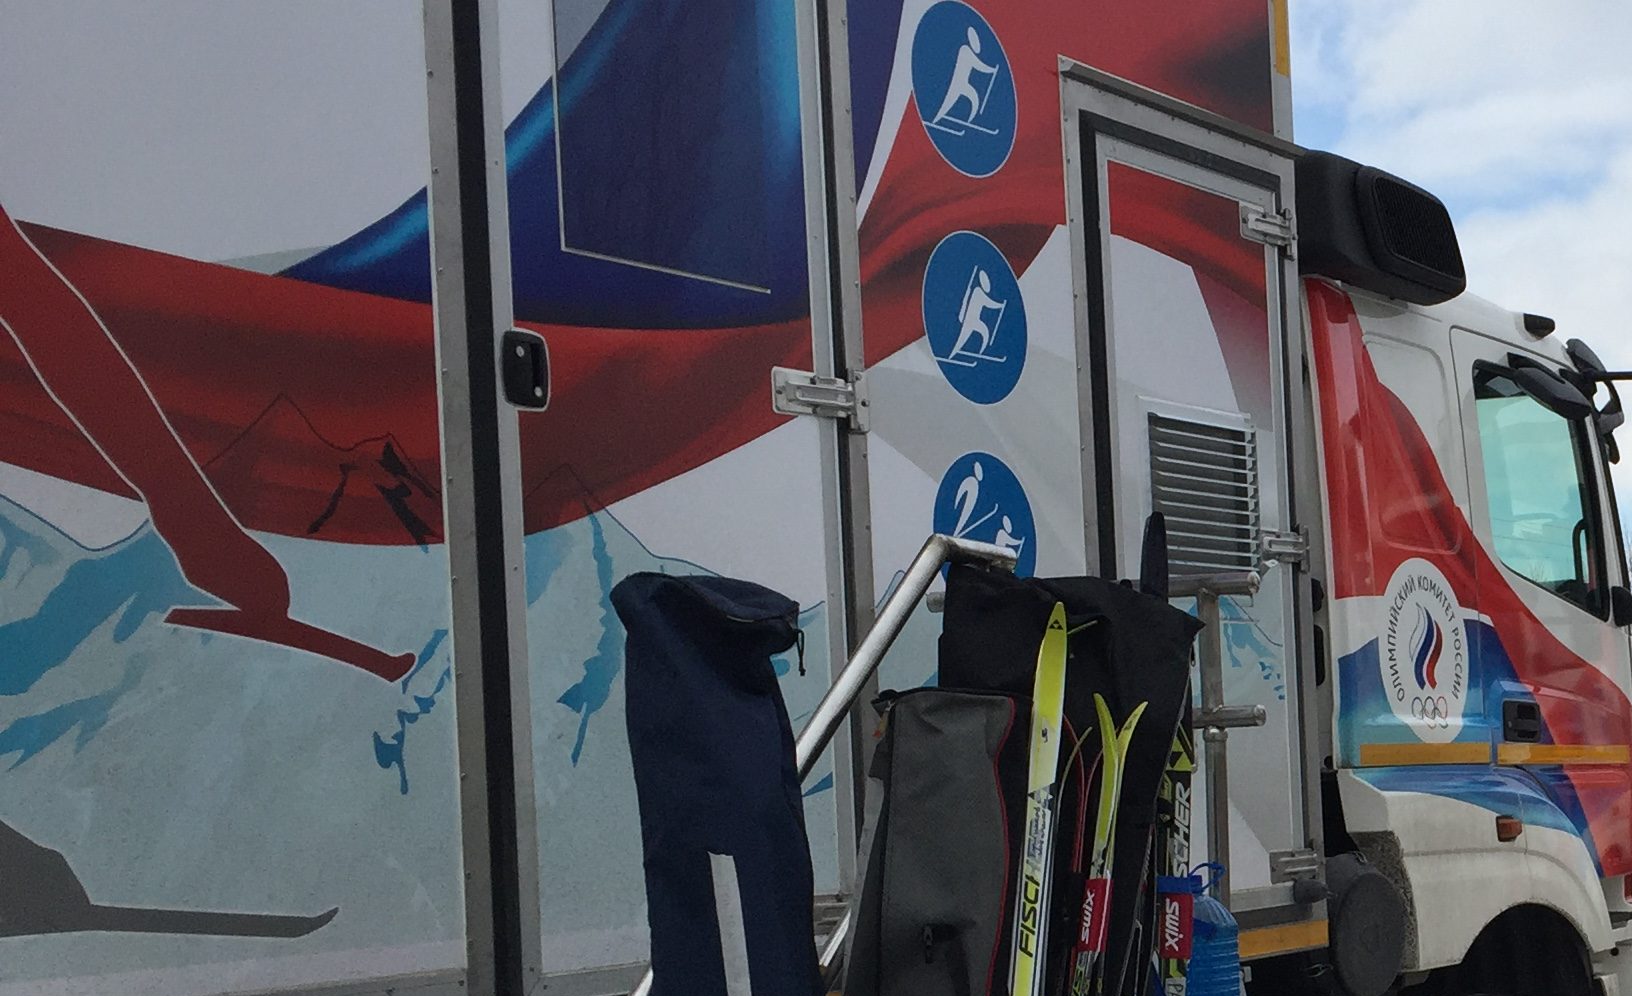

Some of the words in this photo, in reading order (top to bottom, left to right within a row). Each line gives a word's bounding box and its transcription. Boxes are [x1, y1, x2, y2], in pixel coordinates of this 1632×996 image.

[1387, 575, 1417, 702] ОЛИМПИЙСКИЙ
[1417, 575, 1456, 622] КОМИТЕТ
[1451, 626, 1464, 700] РОССИИ
[1172, 781, 1191, 878] SCHER
